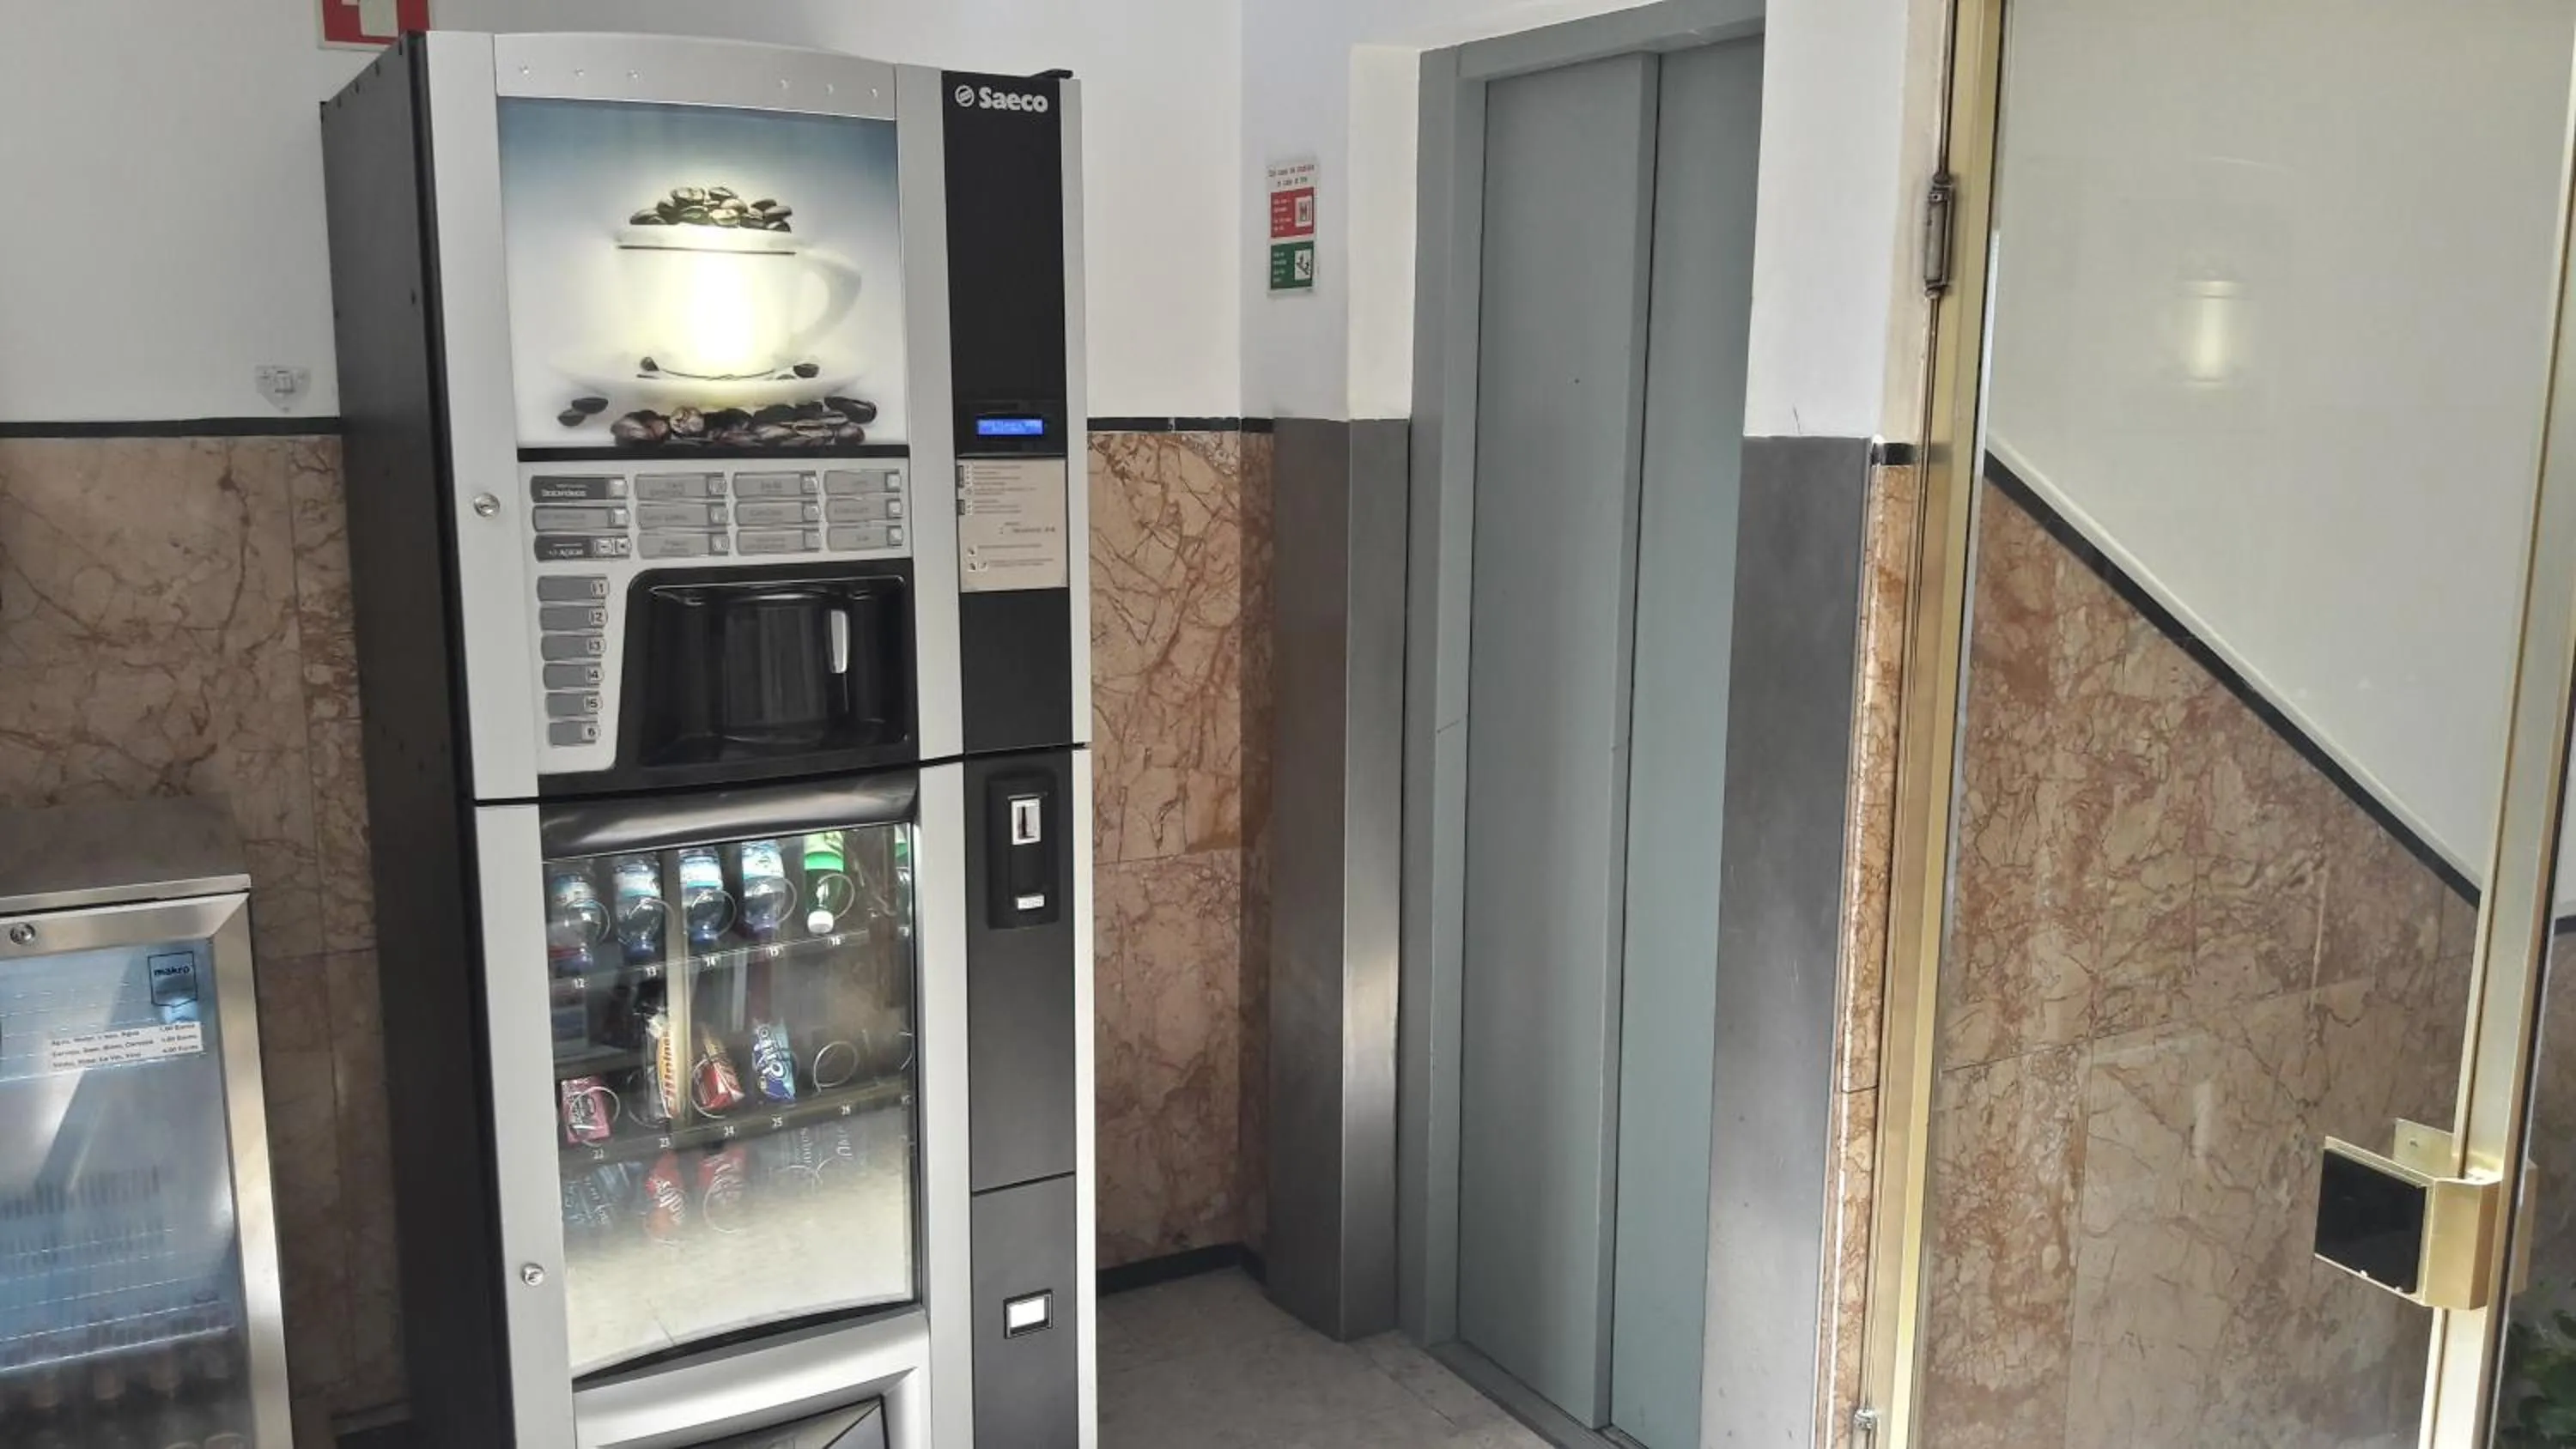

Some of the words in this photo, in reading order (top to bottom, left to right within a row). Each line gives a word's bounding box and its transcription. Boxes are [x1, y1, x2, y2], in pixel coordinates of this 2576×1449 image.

[979, 87, 1048, 113] Saeco
[769, 947, 780, 958] 15
[154, 965, 191, 976] makro
[646, 966, 657, 977] 13
[574, 978, 586, 989] 12
